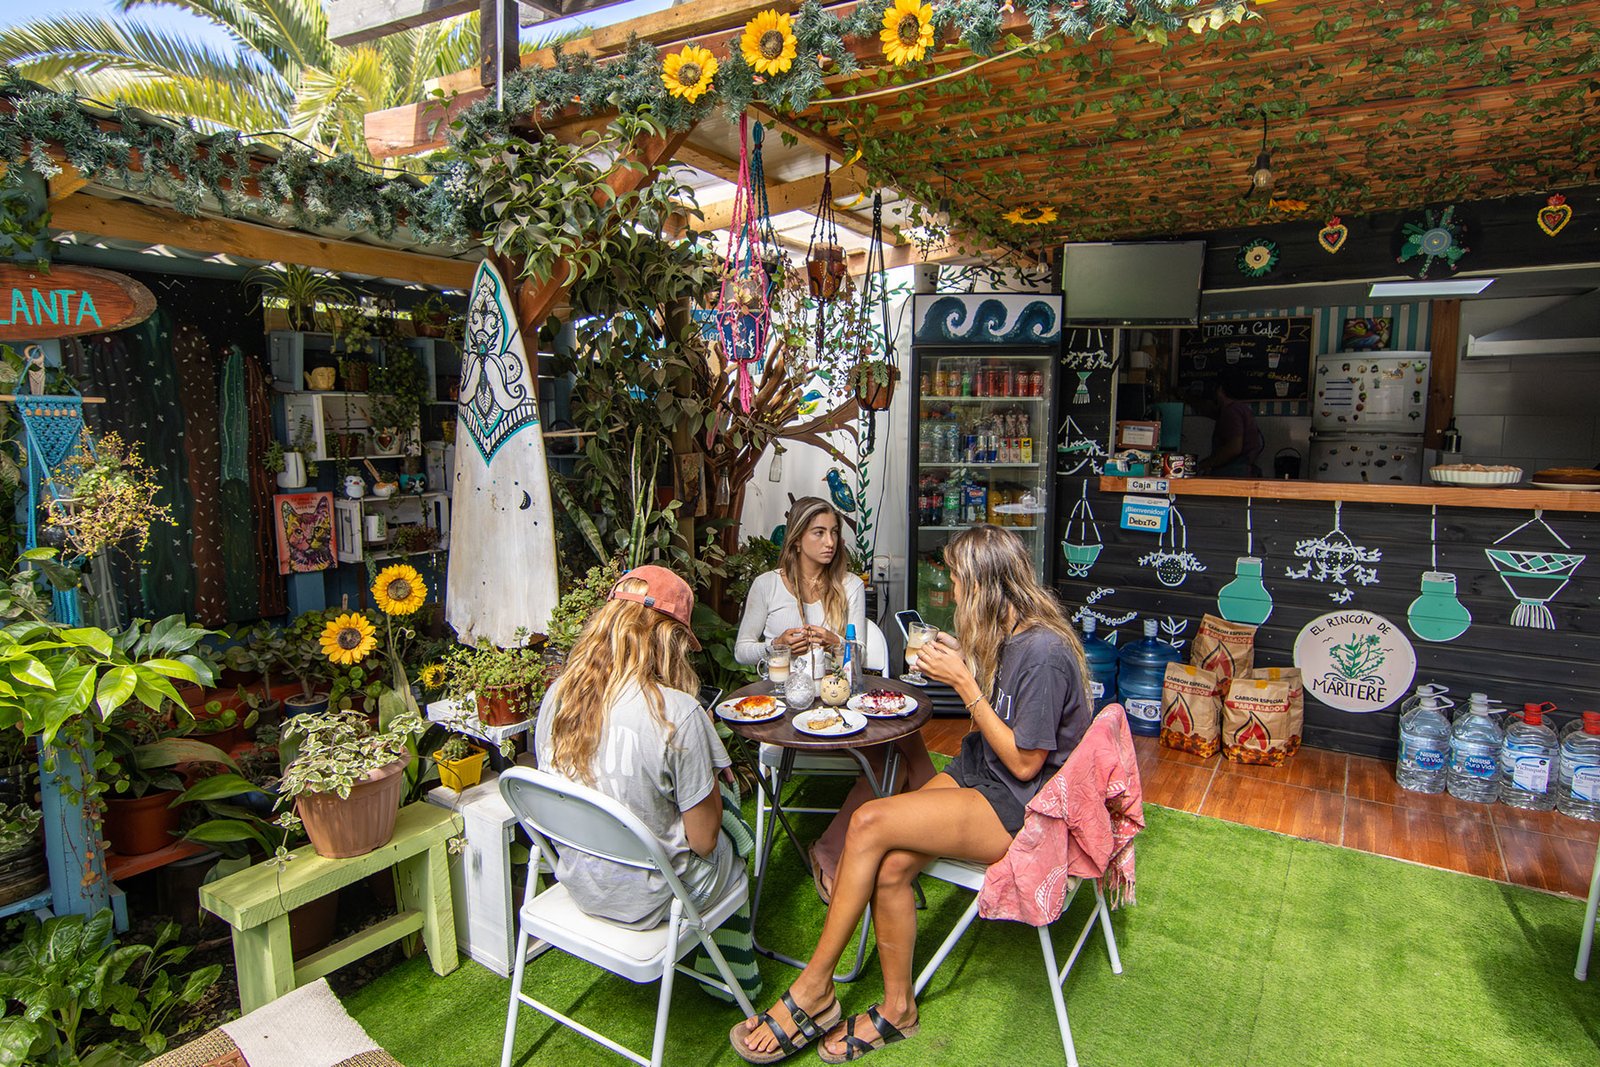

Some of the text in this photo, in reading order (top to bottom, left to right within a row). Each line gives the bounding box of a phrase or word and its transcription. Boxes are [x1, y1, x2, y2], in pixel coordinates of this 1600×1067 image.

[1206, 324, 1235, 336] TIPOS
[1132, 481, 1151, 490] Caja
[1125, 505, 1166, 516] ¡Bienvenidos!
[1309, 613, 1392, 636] EL RINCÓN DE
[1166, 675, 1211, 690] CARBON ESPECIAL
[1165, 681, 1210, 696] PARA ASADOS
[1312, 678, 1387, 703] MARITERE
[1234, 702, 1255, 710] PARA
[1415, 755, 1431, 763] Pura
[1464, 761, 1480, 769] Pura
